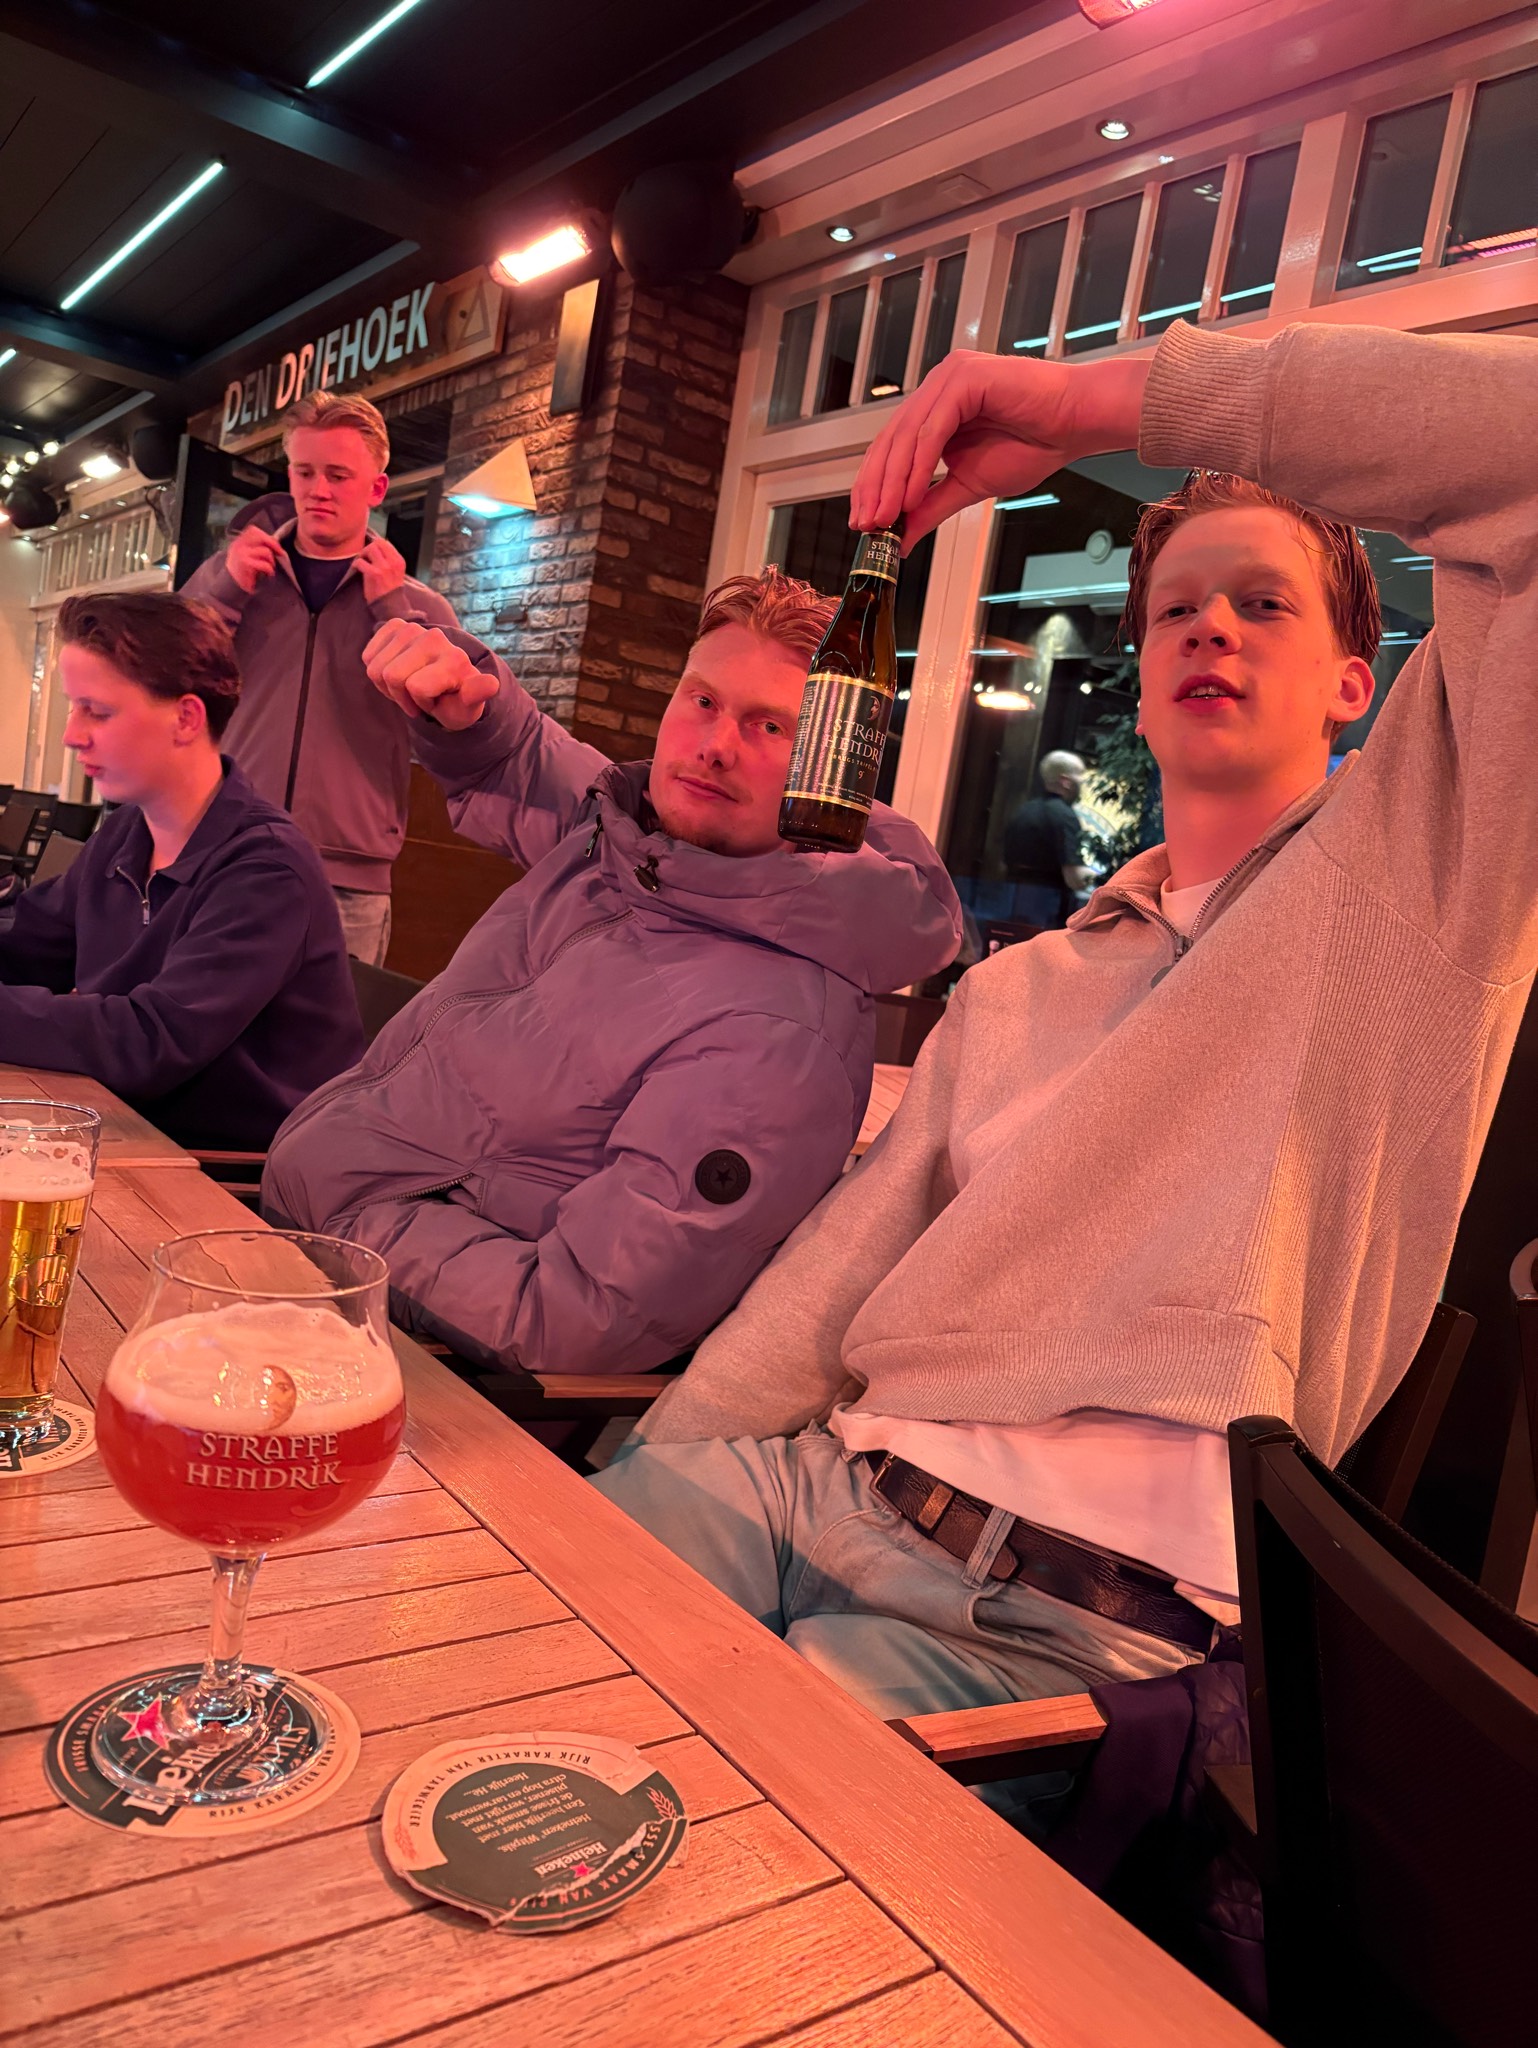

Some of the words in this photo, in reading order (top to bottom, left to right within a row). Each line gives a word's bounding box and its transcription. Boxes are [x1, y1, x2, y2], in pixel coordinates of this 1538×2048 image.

[222, 363, 272, 432] DEN
[275, 281, 436, 410] DRIEHOEK
[871, 541, 899, 556] STRA
[833, 719, 887, 747] STRAFF
[825, 734, 884, 765] HENDRI
[200, 1432, 339, 1465] STRAFFE
[185, 1457, 345, 1490] HENDRIK
[477, 1751, 551, 1763] KARAKTER
[559, 1751, 591, 1765] RIJK
[446, 1761, 473, 1775] VAN
[487, 1772, 529, 1790] Heerlijk
[542, 1774, 567, 1786] citra
[507, 1790, 522, 1799] en
[522, 1782, 544, 1793] hop
[409, 1775, 446, 1827] TARWEBIER
[560, 1792, 573, 1800] de
[563, 1799, 586, 1810] Een
[461, 1814, 484, 1827] met
[524, 1806, 566, 1826] heerlijk
[502, 1821, 526, 1834] bier
[477, 1830, 501, 1844] met
[534, 1841, 607, 1877] Heineken
[599, 1851, 646, 1890] SMAAK
